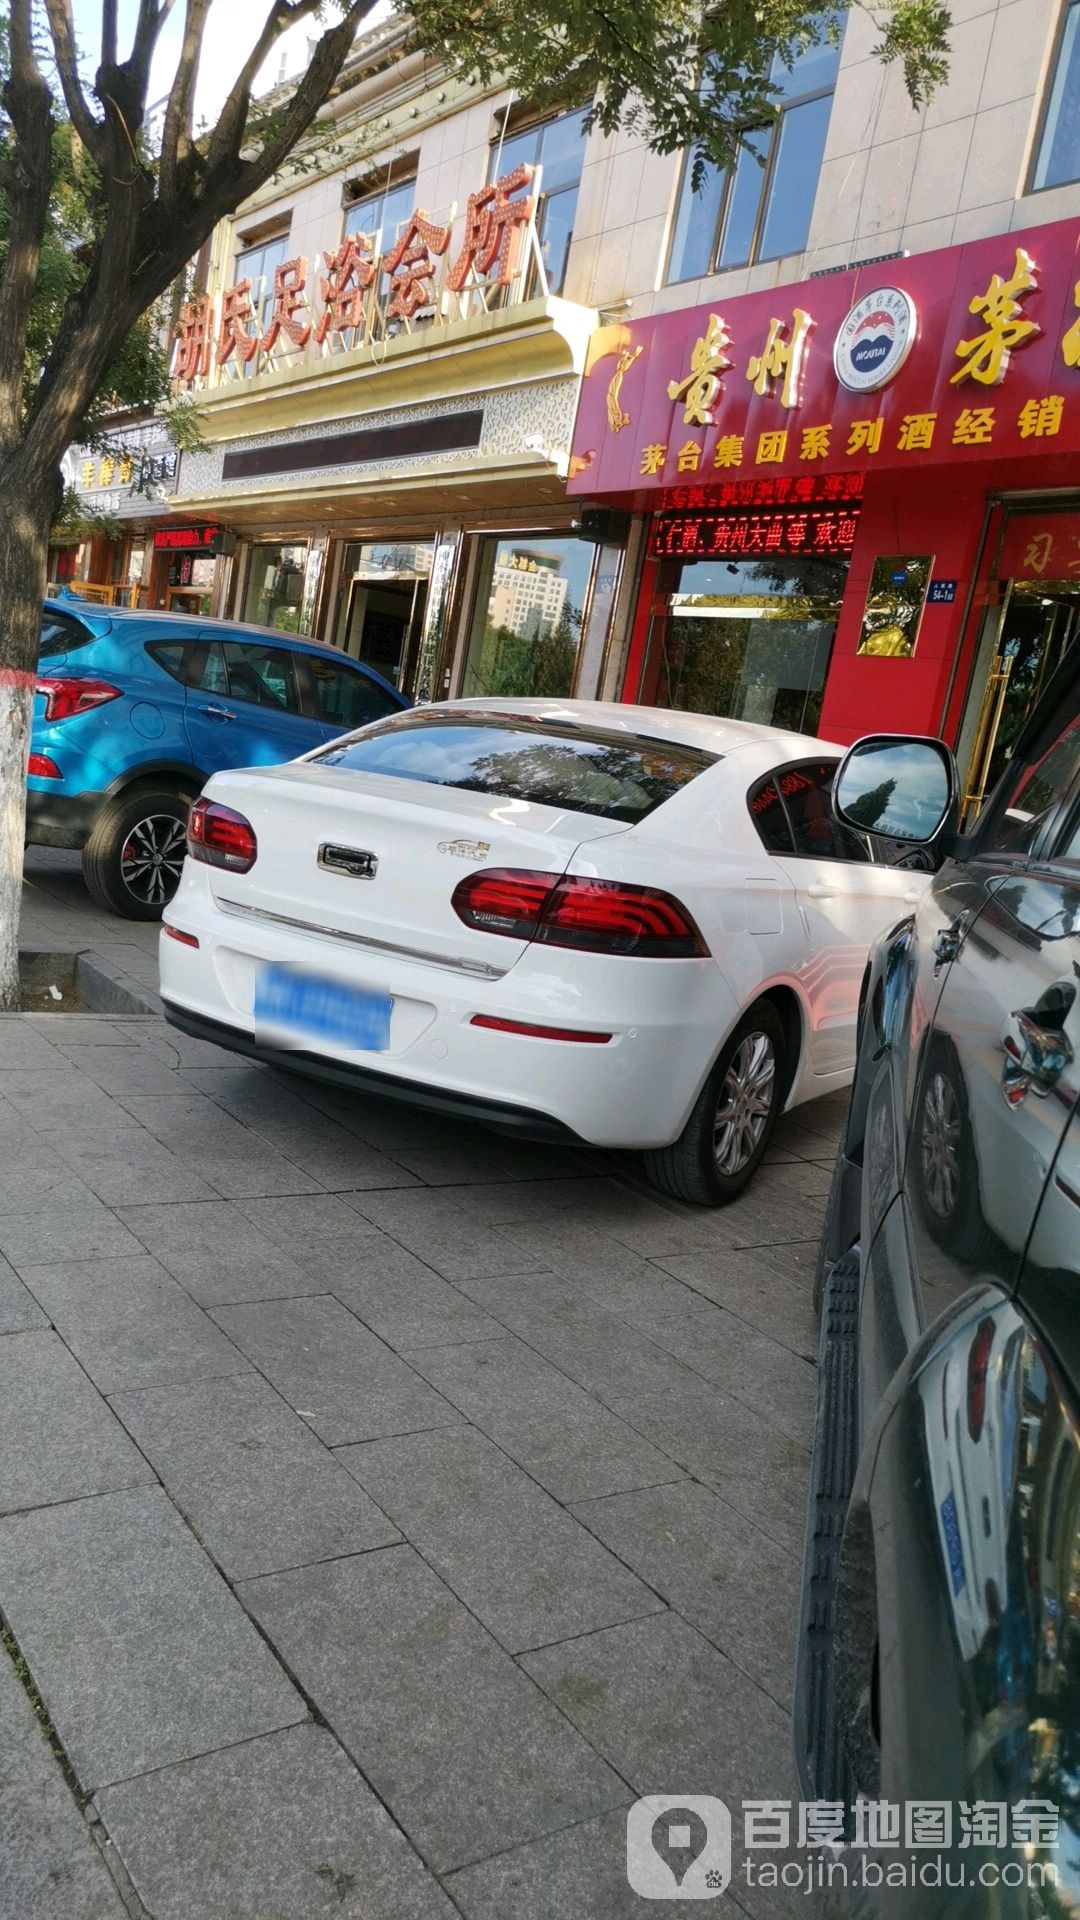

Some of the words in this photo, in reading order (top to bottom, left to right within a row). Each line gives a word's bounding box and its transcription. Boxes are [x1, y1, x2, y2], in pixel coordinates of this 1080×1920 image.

[667, 309, 814, 424] 贵州
[855, 347, 886, 361] MOUTAI
[640, 395, 1065, 475] 茅台集团系列酒经销
